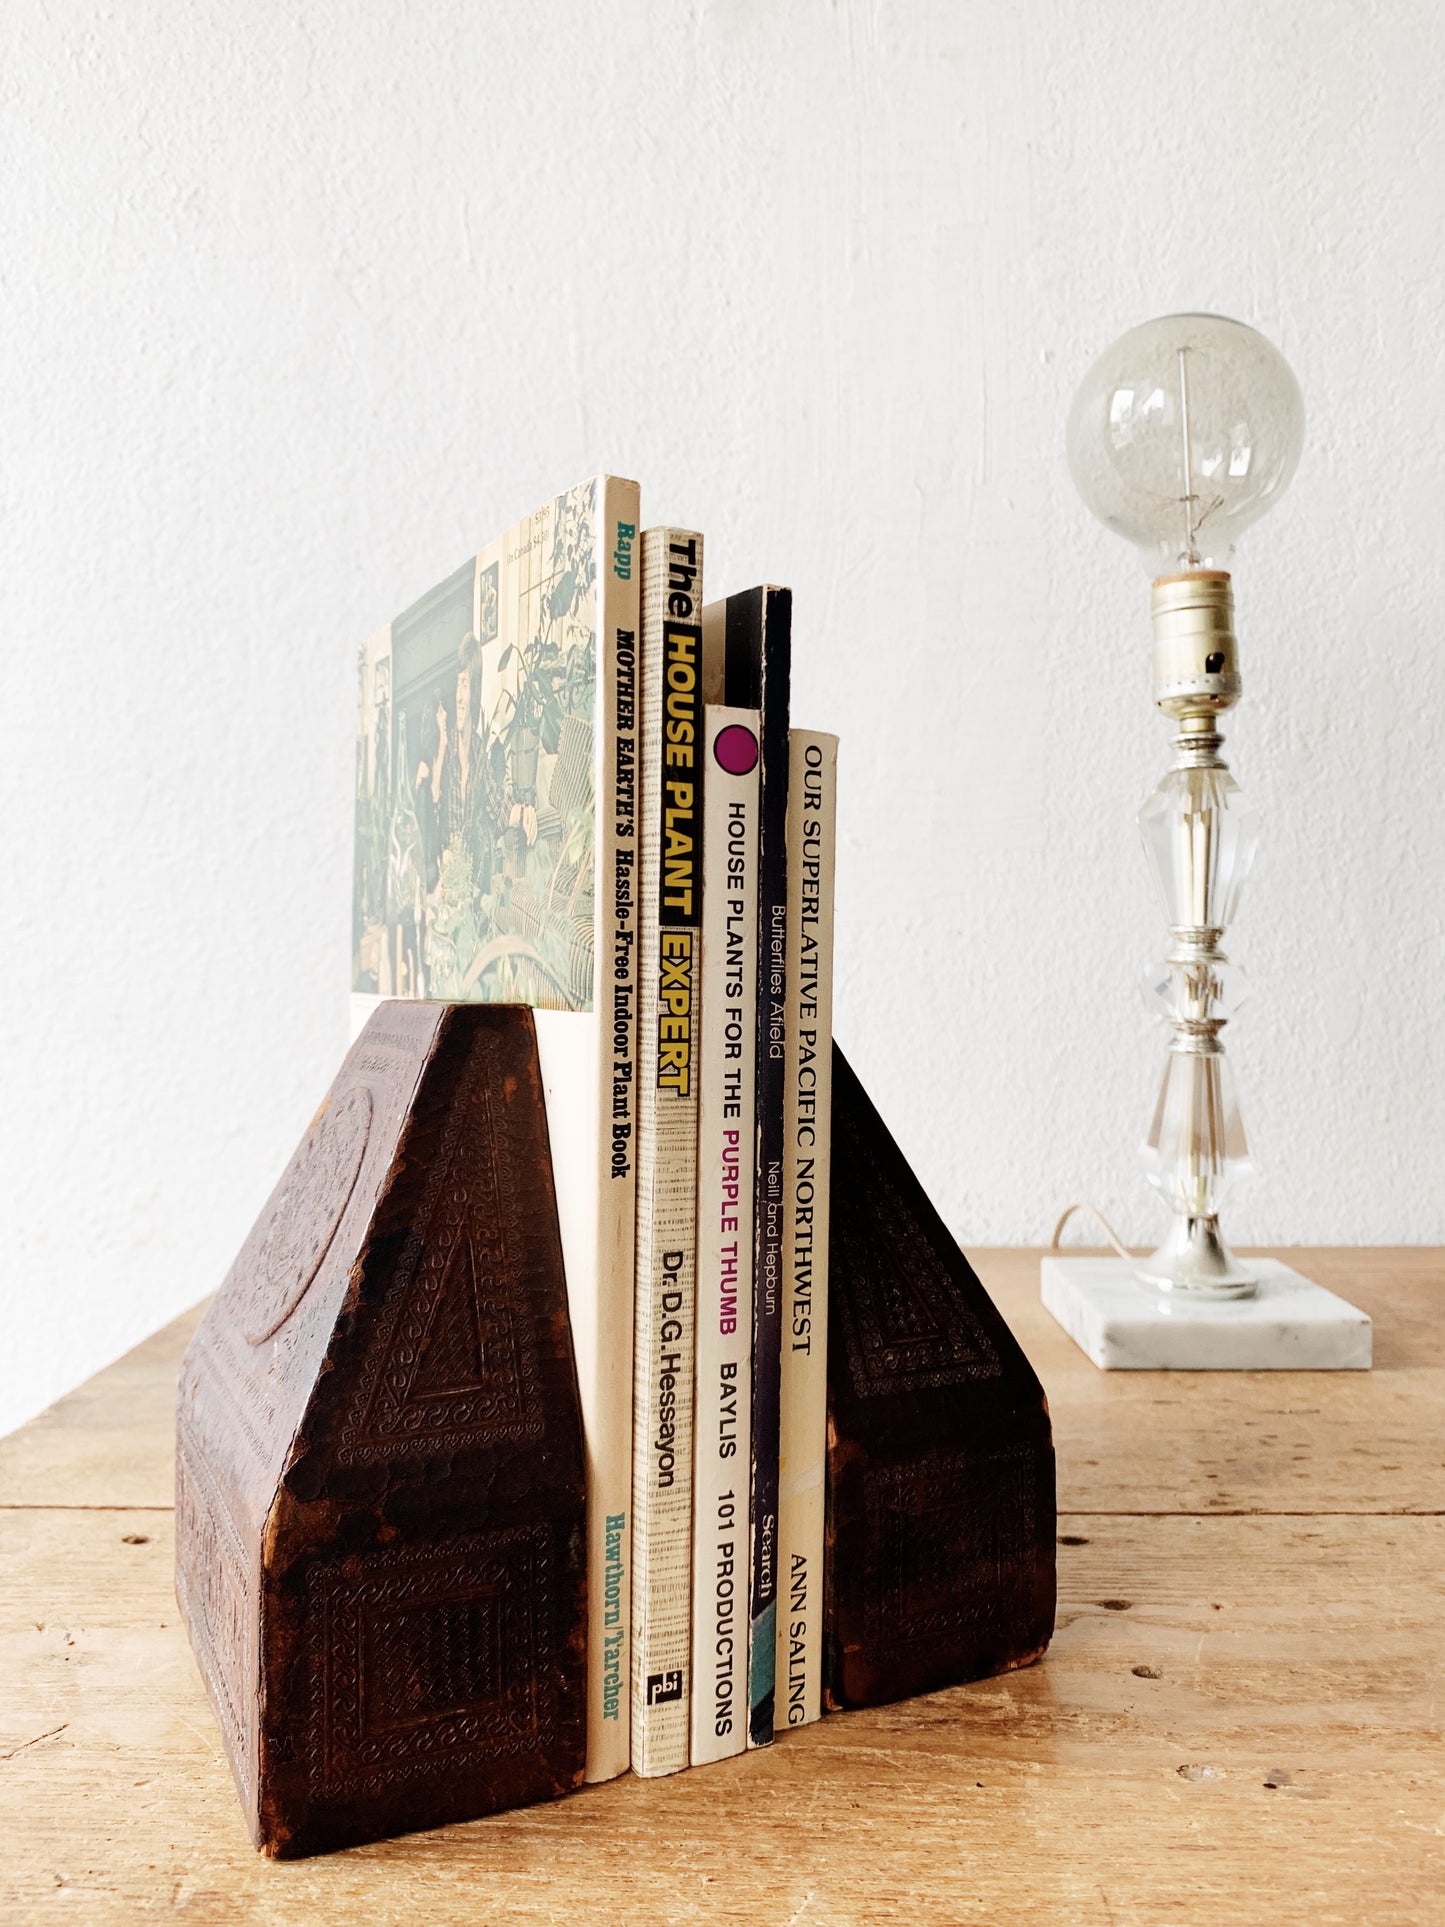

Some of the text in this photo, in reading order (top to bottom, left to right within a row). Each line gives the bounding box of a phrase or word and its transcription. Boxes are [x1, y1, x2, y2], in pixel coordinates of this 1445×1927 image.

[614, 521, 635, 580] Rapp
[669, 539, 696, 617] The
[666, 634, 695, 767] HOUSE
[611, 629, 634, 1179] MOTHER EARTH'S Hassle-Free Indoor Plant Book
[664, 781, 694, 915] PLANT
[657, 931, 693, 1096] EXPERT
[769, 905, 786, 1058] Butterflies Afield
[792, 745, 822, 1356] OUR SUPERLATIVE PACIFIC NORTHWEST
[720, 803, 746, 1335] HOUSE PLANTS FOR THE PURPLE THUMB
[662, 1251, 684, 1286] Dr.
[764, 1162, 780, 1315] Neill and Hepburn
[718, 1362, 738, 1458] BAYLIS
[603, 1512, 626, 1720] Hawthorn/Tarcher
[714, 1489, 735, 1737] 101 PRODUCTIONS
[760, 1514, 776, 1598] Search
[651, 1671, 679, 1706] pbi
[787, 1553, 808, 1725] ANN SALING
